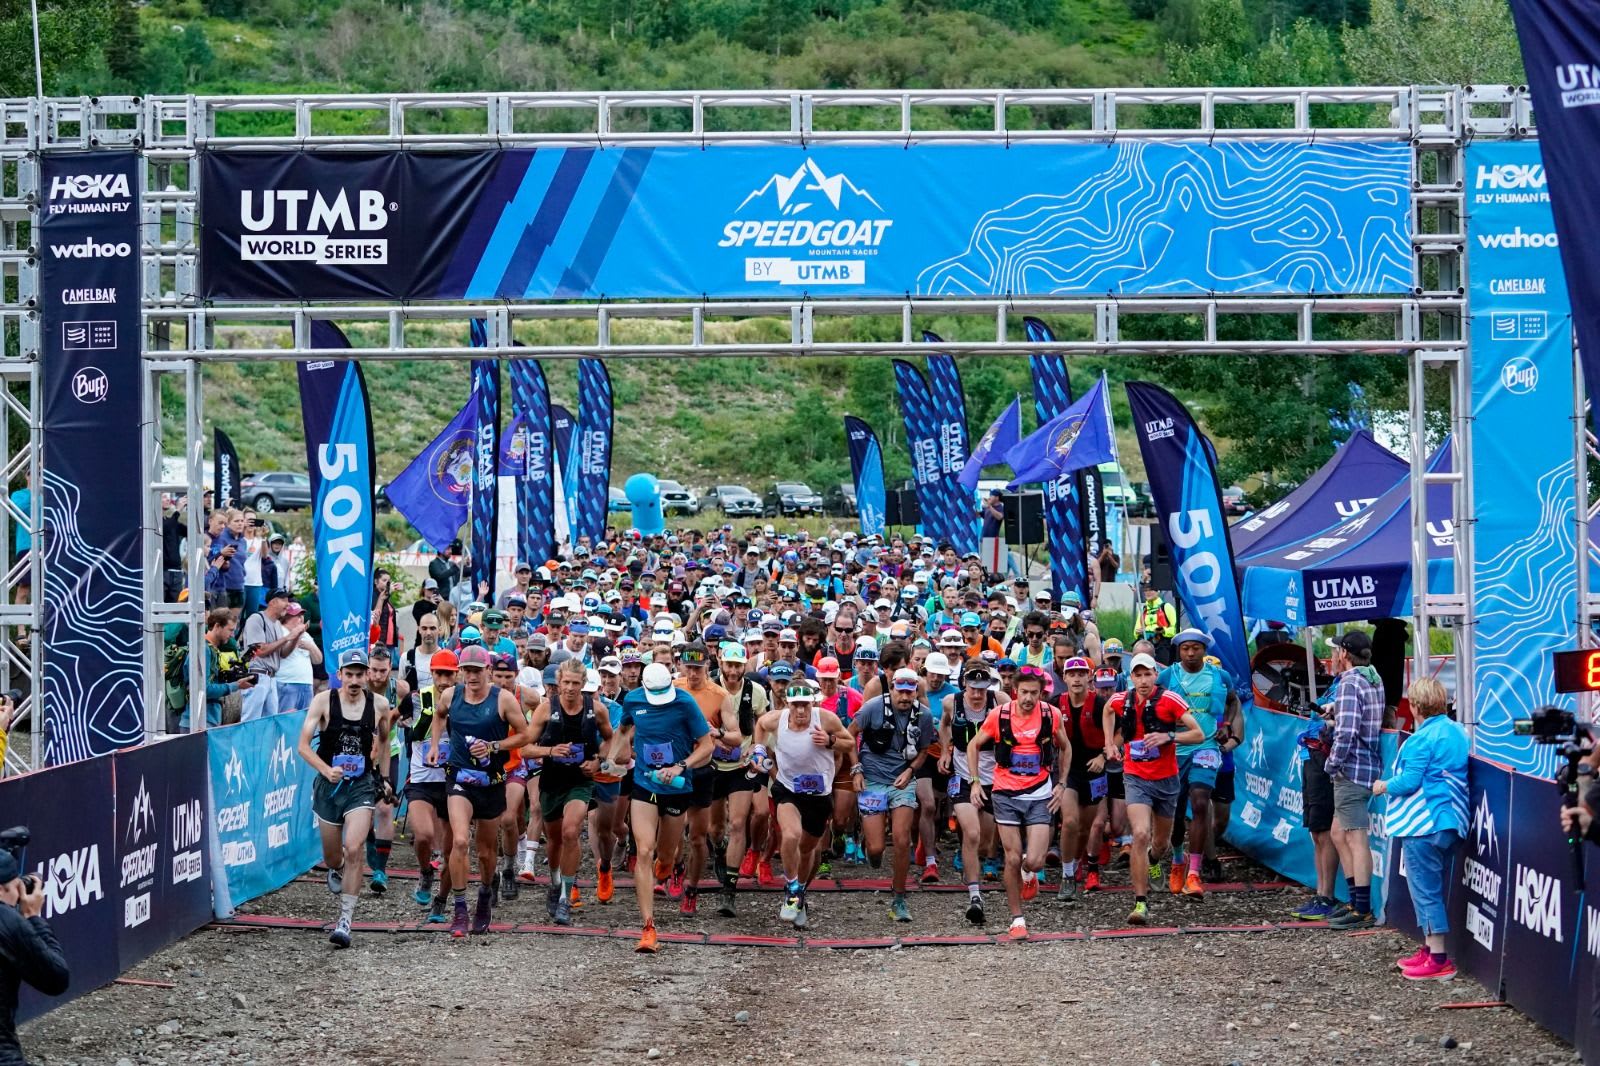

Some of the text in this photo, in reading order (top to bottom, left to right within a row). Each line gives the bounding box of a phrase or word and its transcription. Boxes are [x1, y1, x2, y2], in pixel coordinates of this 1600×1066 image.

[50, 174, 131, 199] HOKA
[1476, 192, 1551, 203] FLY HUMAN FL
[50, 202, 130, 214] FLY HUMAN FLY
[718, 220, 893, 247] SPEEDGOAT
[1477, 226, 1559, 248] wahoo
[50, 237, 131, 258] wahoo
[248, 241, 382, 259] WORLD SERIES
[753, 262, 850, 280] BY UTMB
[63, 288, 116, 304] CAMELBAK
[1490, 278, 1546, 295] CAMELBAK
[1145, 417, 1173, 433] UTMB
[483, 423, 493, 488] UTMB
[530, 432, 545, 481] UTMB
[591, 431, 605, 474] UTMB
[945, 422, 964, 472] UTMB
[922, 438, 941, 483] UTMB
[1086, 474, 1100, 531] snowbird
[318, 443, 366, 588] 50K
[1312, 576, 1375, 598] UTMB
[1317, 598, 1374, 609] WORLD SERIES
[651, 752, 664, 760] 92
[864, 799, 882, 807] 377
[173, 797, 202, 851] UTMB
[120, 843, 157, 888] SPEEDGOAT
[37, 844, 103, 919] HOKA
[1462, 856, 1501, 906] SPEEDGOAT
[1514, 863, 1562, 943] HOKA
